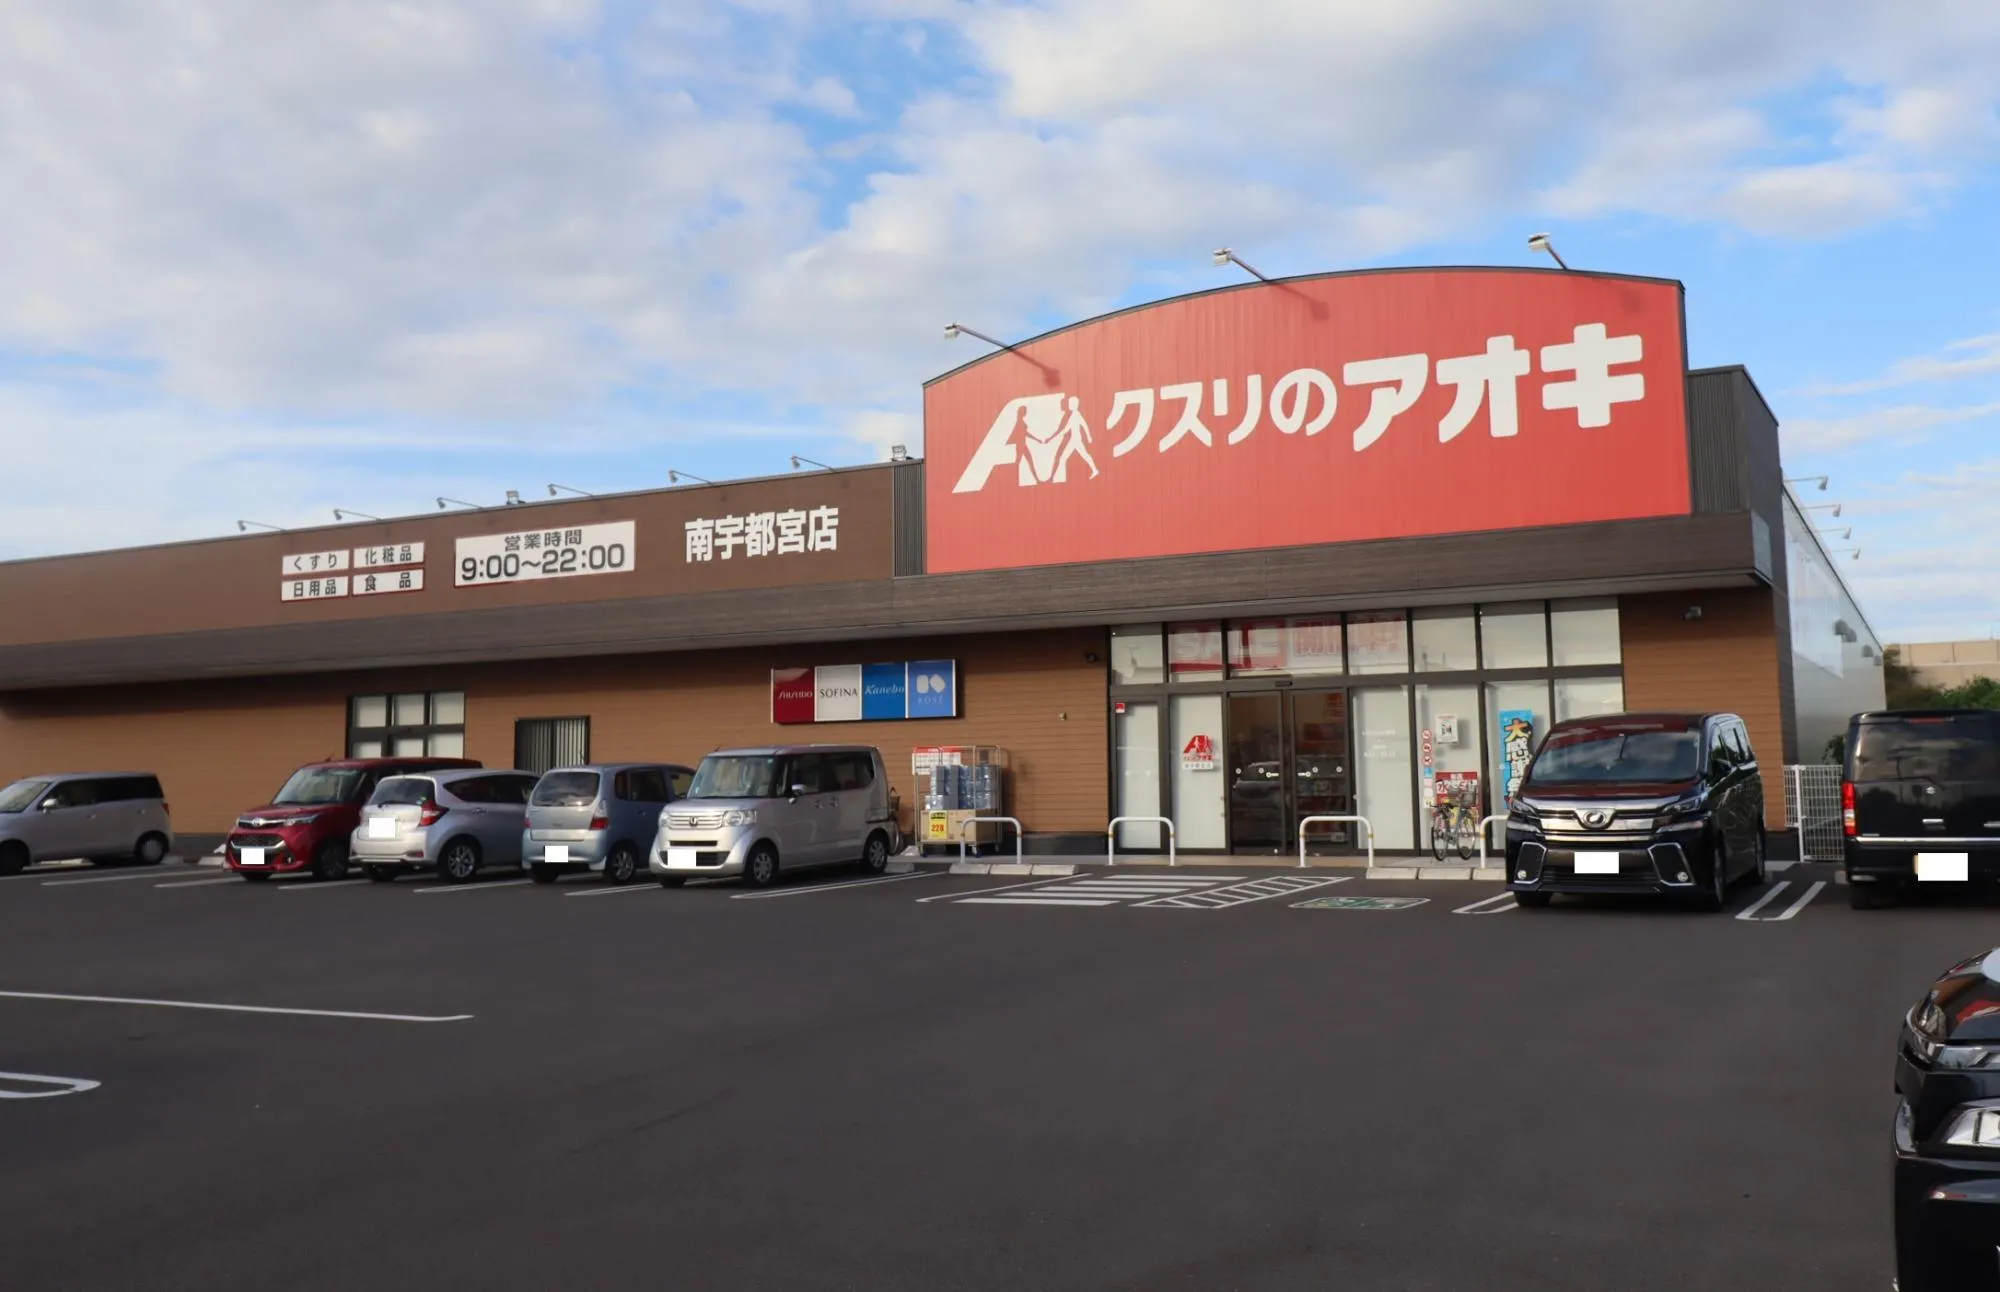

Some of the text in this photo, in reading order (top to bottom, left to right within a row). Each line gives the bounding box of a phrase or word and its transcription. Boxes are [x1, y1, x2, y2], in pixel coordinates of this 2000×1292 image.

[1106, 322, 1646, 458] クスリのアオキ
[503, 528, 583, 552] 営業時間
[685, 505, 839, 563] 南宇都宮店
[293, 553, 337, 571] くすり
[364, 545, 412, 565] 化粧品
[293, 579, 337, 598] 日用品
[819, 688, 859, 698] SOFINA
[864, 684, 905, 695] Kanebo
